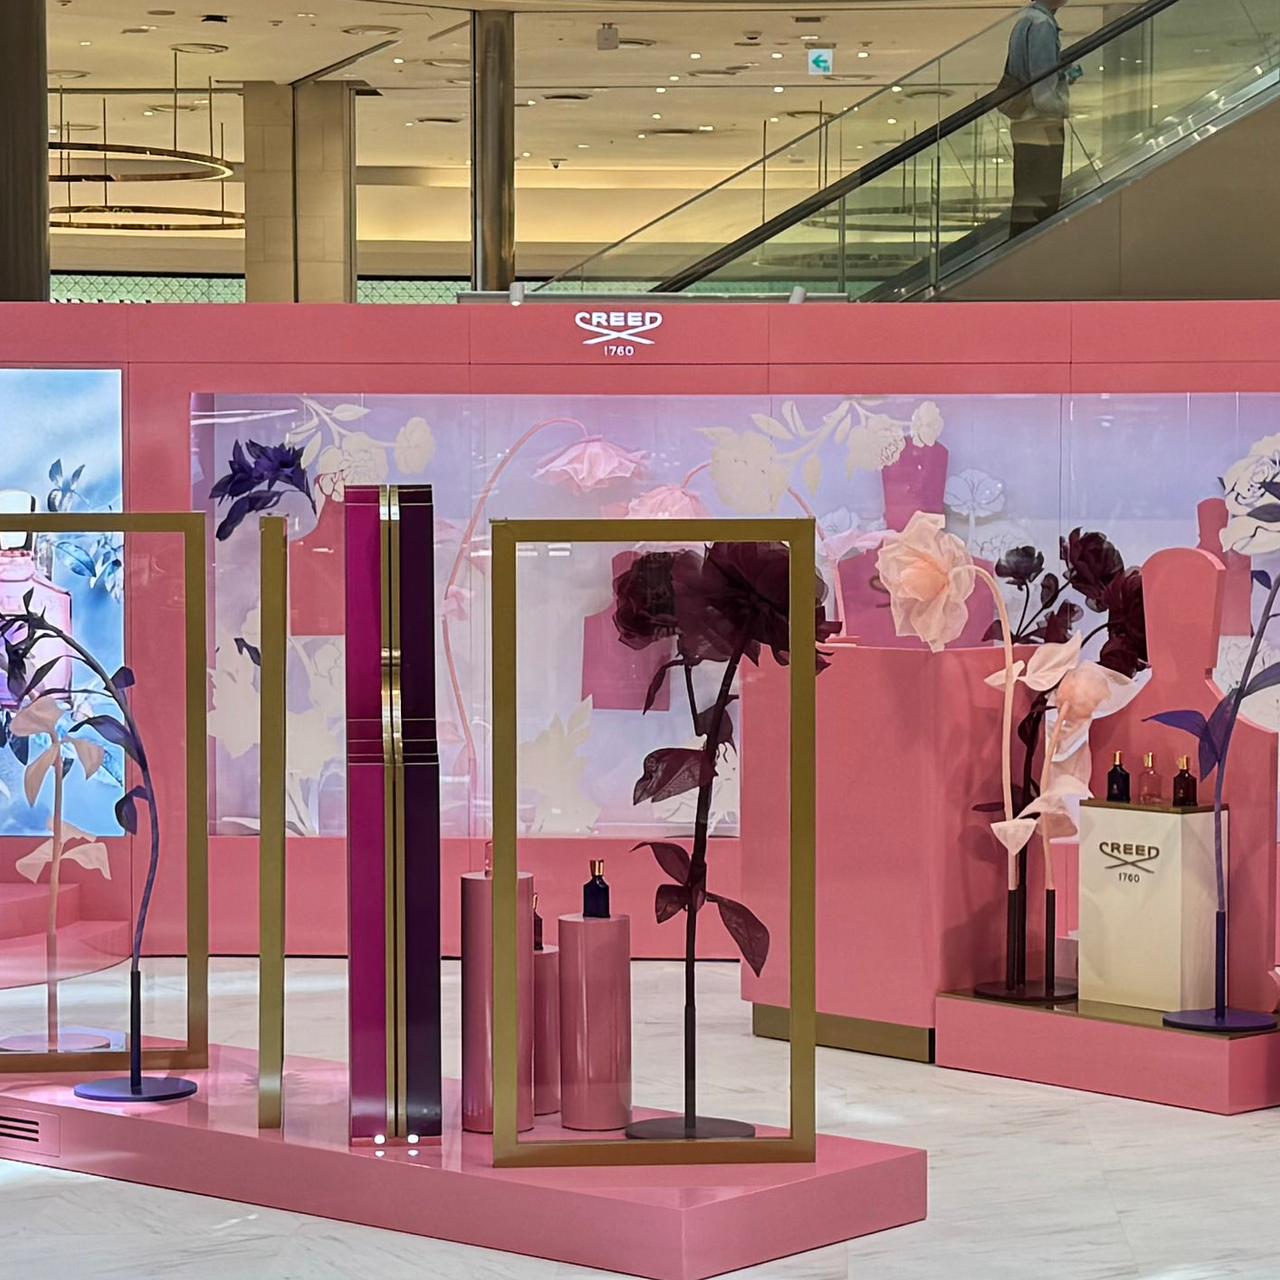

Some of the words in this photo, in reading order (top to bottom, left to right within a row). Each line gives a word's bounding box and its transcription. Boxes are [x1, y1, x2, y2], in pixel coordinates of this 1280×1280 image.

[575, 312, 662, 334] CREED
[604, 346, 634, 356] 1760
[1099, 841, 1160, 864] CREED
[1118, 872, 1140, 883] 1760
